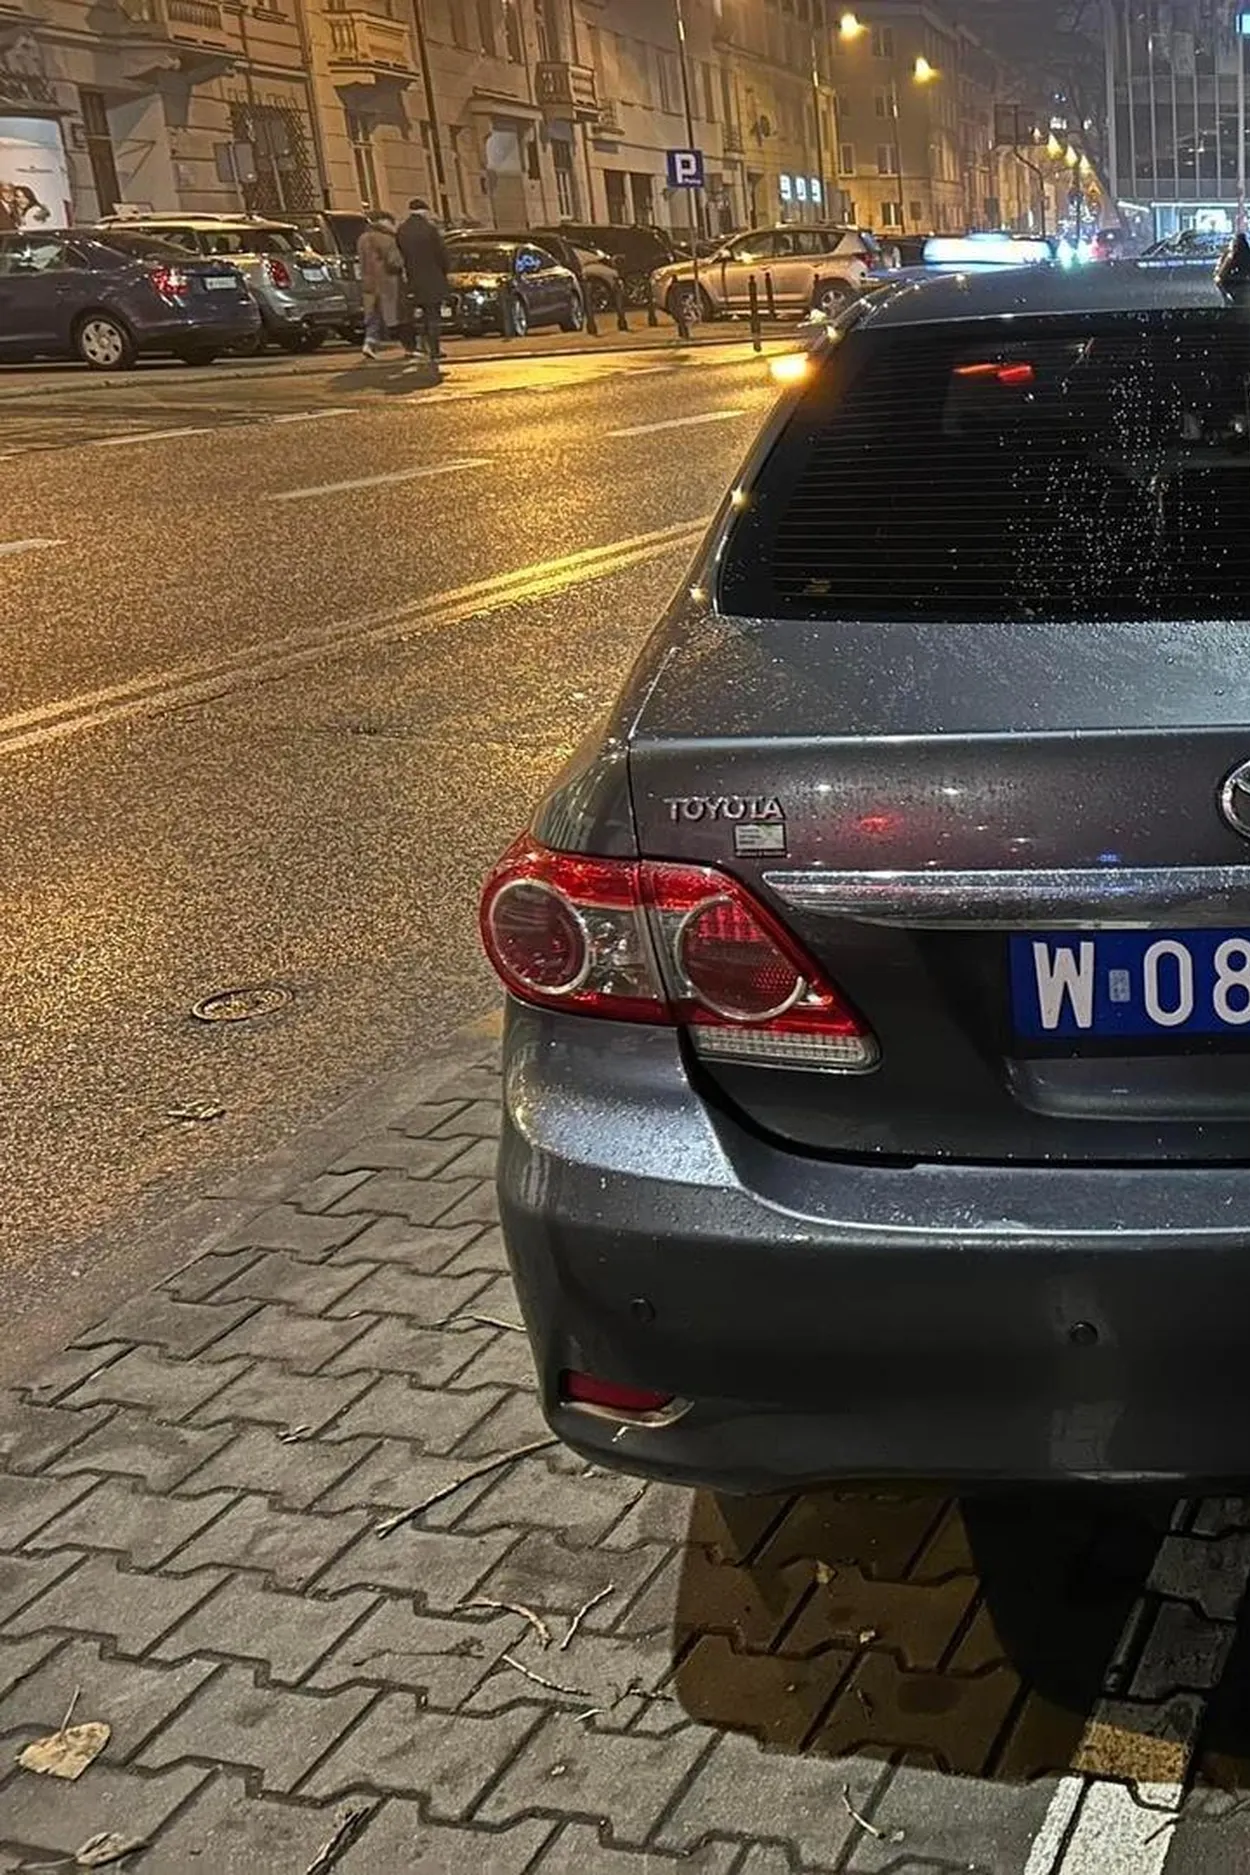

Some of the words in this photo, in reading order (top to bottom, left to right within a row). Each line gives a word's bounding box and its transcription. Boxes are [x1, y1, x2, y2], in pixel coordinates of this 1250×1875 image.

[675, 153, 697, 184] P
[663, 796, 785, 821] TOYOTA
[1033, 941, 1095, 1029] W
